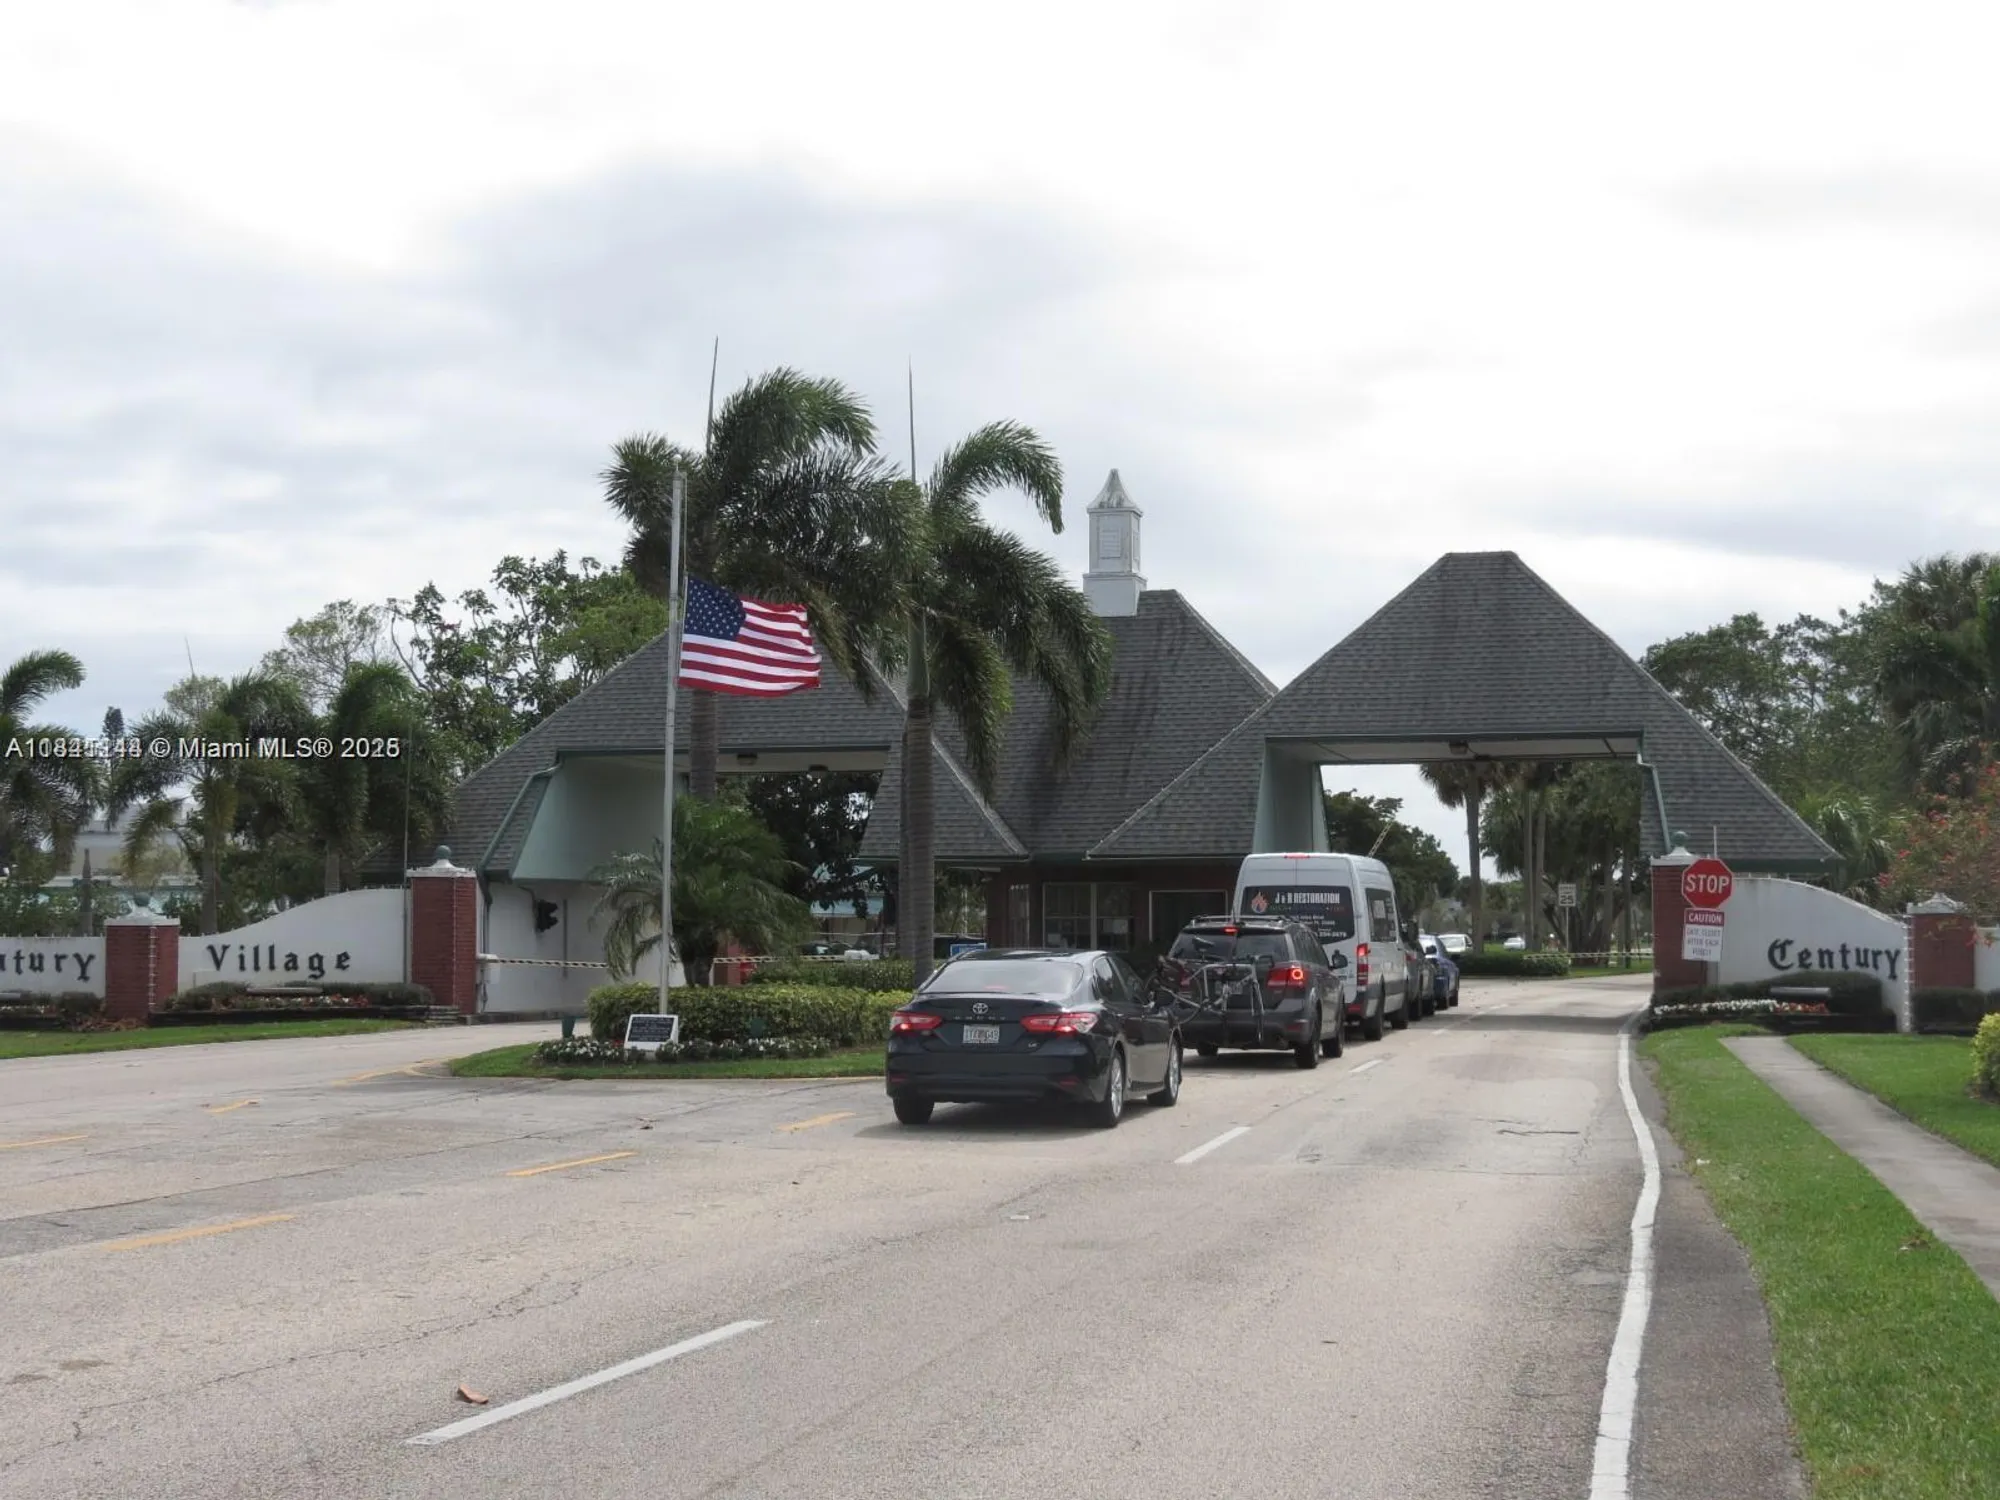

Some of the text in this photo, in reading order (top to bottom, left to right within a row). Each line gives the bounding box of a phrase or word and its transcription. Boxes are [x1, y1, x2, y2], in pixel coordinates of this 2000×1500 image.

[1685, 874, 1730, 894] STOP
[1293, 892, 1340, 904] RESTORATION
[1688, 913, 1722, 924] CAUTION
[206, 944, 352, 979] Village
[1767, 938, 1901, 980] Century
